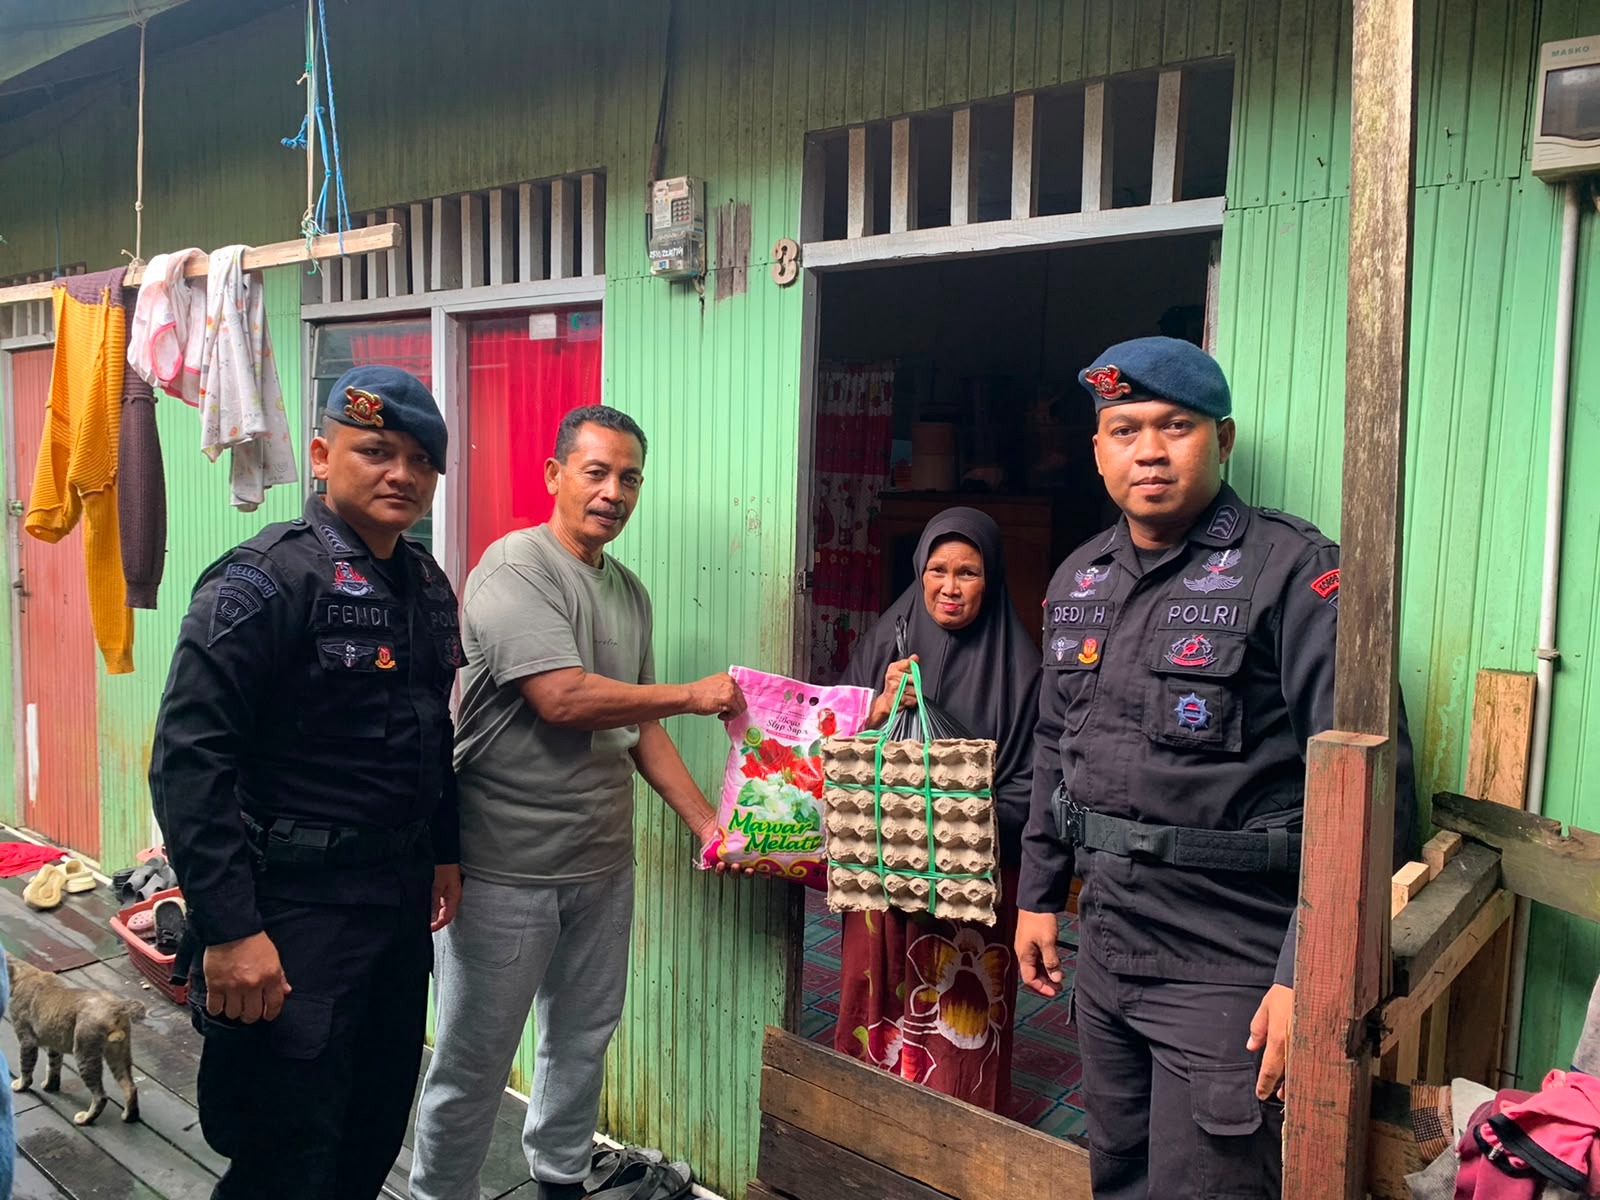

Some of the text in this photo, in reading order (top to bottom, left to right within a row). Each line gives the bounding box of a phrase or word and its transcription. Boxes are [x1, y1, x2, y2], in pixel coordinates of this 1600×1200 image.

[1551, 45, 1590, 57] MASKO
[772, 238, 798, 285] 3
[327, 604, 391, 627] FENDI
[1053, 606, 1106, 624] DEDI H
[1167, 605, 1238, 626] POLRI
[728, 808, 812, 835] Mawar
[743, 831, 823, 854] Melati
